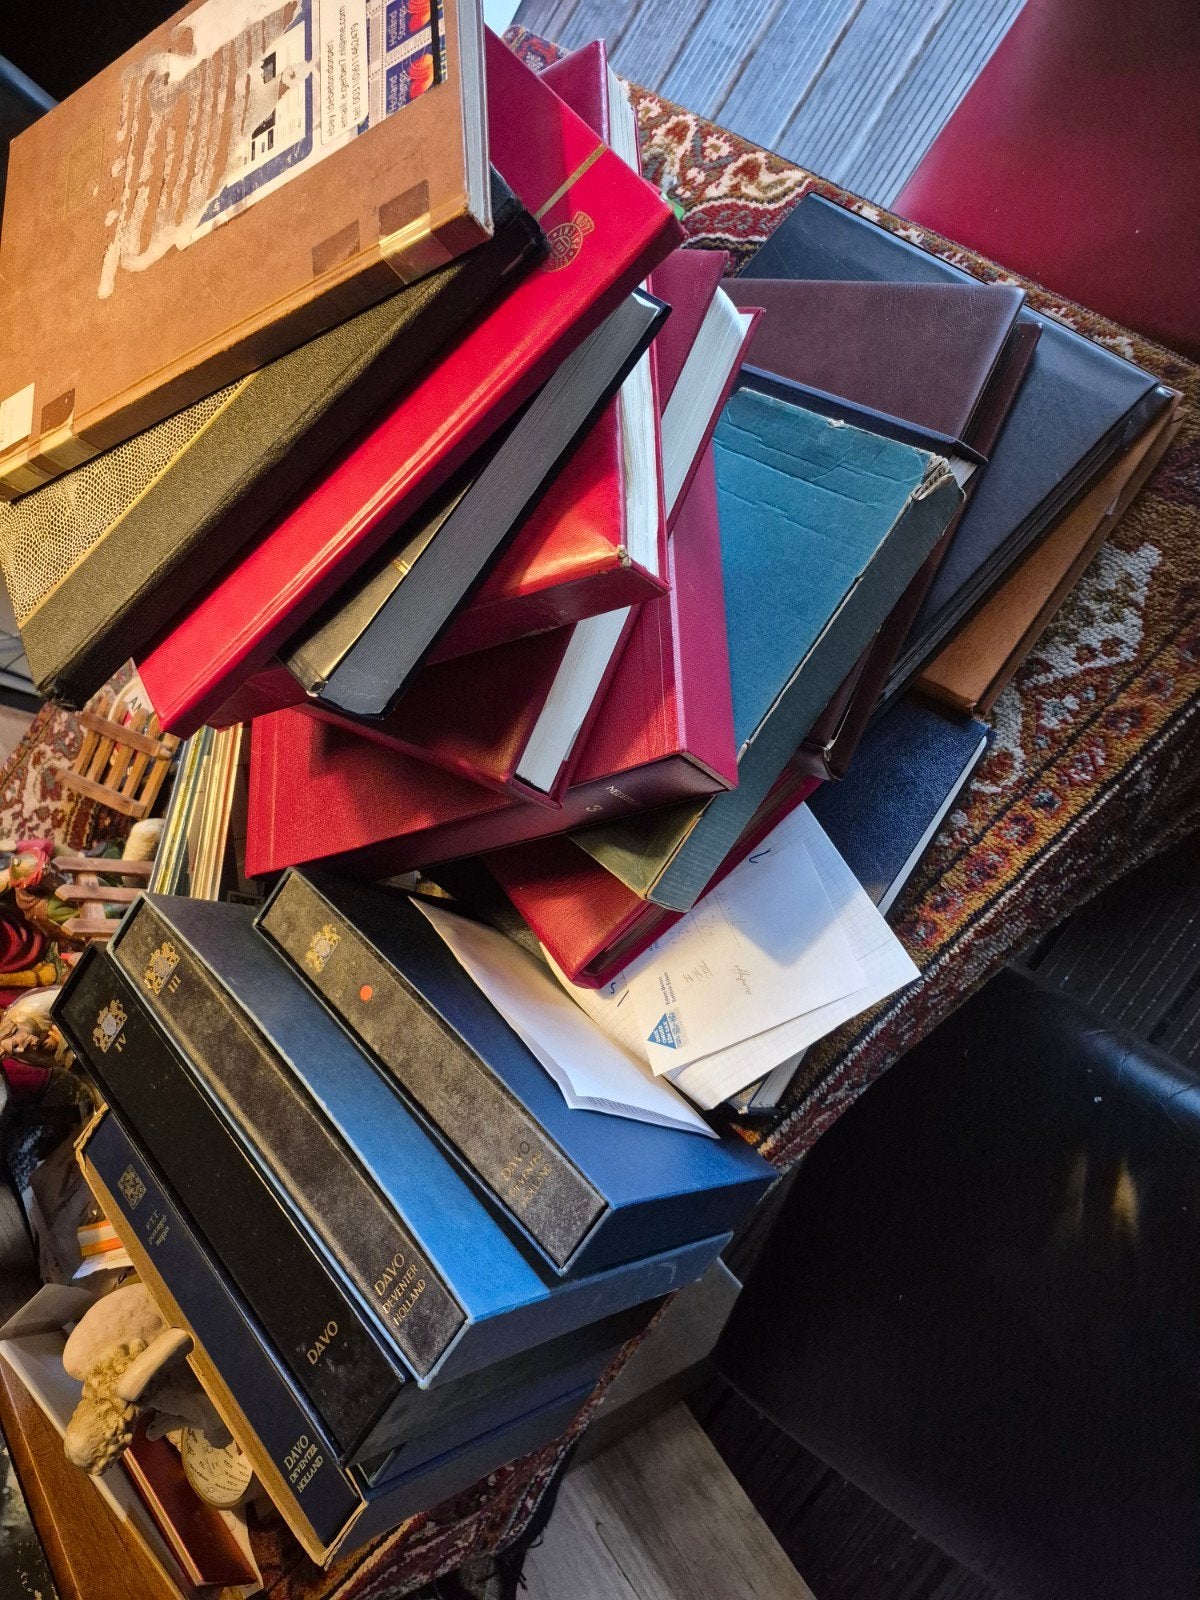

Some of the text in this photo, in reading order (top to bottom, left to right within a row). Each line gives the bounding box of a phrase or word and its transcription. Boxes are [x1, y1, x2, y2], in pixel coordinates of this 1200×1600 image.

[388, 10, 398, 46] Holland
[398, 5, 408, 40] Stamps
[388, 75, 398, 113] Holland
[114, 1033, 127, 1053] IV
[374, 1253, 405, 1296] DAVO
[381, 1263, 419, 1314] DEVENTER
[392, 1279, 426, 1326] HOLLAND
[306, 1320, 339, 1365] DAVO
[283, 1434, 309, 1471] DAVO
[288, 1443, 319, 1484] DEVENTER
[296, 1455, 324, 1493] HOLLAND
